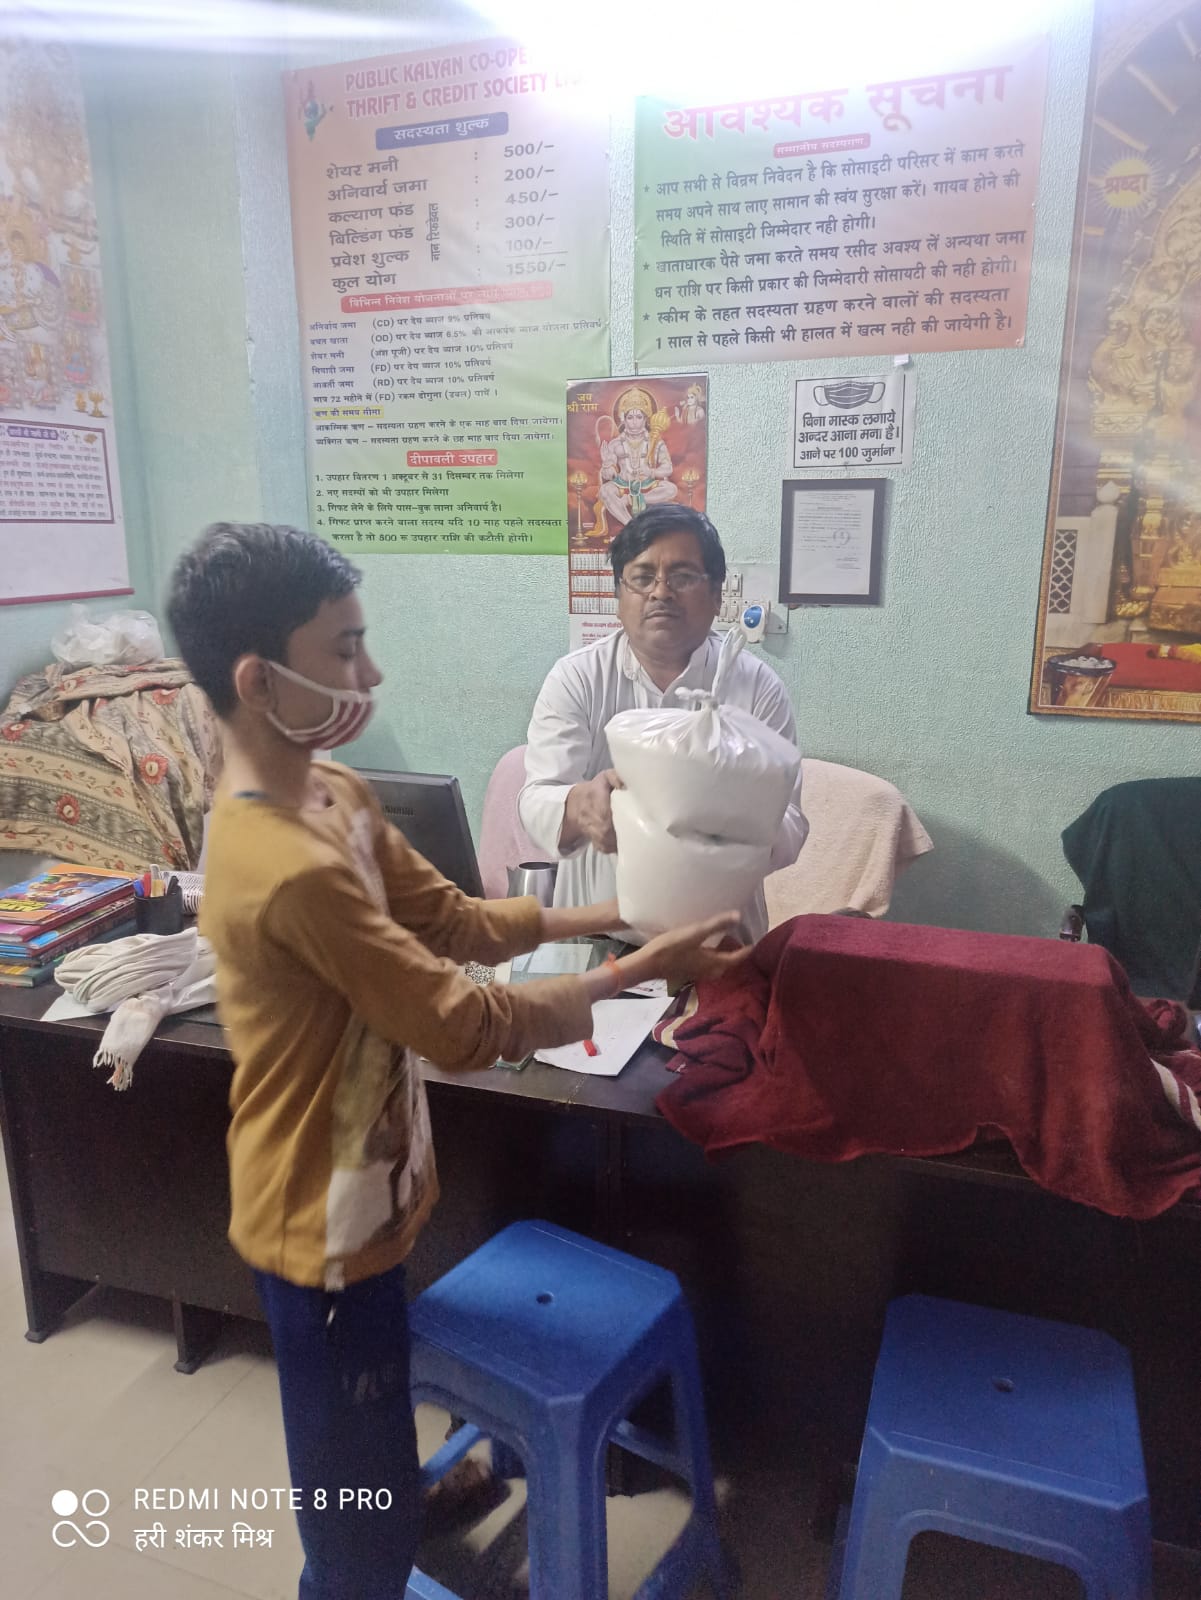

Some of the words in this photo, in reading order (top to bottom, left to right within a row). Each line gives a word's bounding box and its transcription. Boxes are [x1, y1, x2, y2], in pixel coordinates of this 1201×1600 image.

[346, 69, 399, 91] PUBLIC
[403, 56, 463, 83] KALYAN
[347, 93, 401, 117] THRIFT
[406, 92, 416, 108] &
[423, 83, 478, 107] CREDIT
[483, 73, 548, 98] SOCIETY
[664, 88, 848, 140] आवश्यक
[865, 65, 1013, 131] सूचना
[394, 123, 450, 140] सदस्यता
[455, 118, 489, 135] शुल्क
[503, 140, 555, 158] 500/-
[326, 162, 362, 179] शेयर
[367, 155, 399, 173] मनी
[504, 164, 556, 182] 200/-
[656, 181, 680, 196] आप
[683, 174, 708, 193] सभी
[712, 173, 722, 190] से
[762, 166, 803, 184] निवेदन
[805, 160, 817, 181] है
[821, 160, 837, 177] कि
[842, 154, 892, 177] सोसाइटी
[897, 150, 940, 171] परिसर
[944, 147, 956, 165] में
[961, 148, 989, 162] काम
[994, 139, 1025, 160] करते
[328, 179, 388, 201] अनिवार्य
[393, 179, 429, 193] जमा
[504, 188, 560, 205] 450/-
[656, 208, 682, 222] समय
[686, 201, 713, 219] अपने
[745, 199, 768, 215] लाए
[772, 194, 810, 210] सामान
[814, 188, 830, 206] की
[862, 186, 897, 207] सुरक्षा
[974, 171, 998, 193] होने
[1002, 168, 1021, 187] की
[328, 207, 383, 223] कल्याण
[387, 201, 415, 217] फंड
[504, 212, 556, 229] 300/-
[387, 224, 415, 240] फंड
[695, 228, 707, 244] में
[710, 223, 757, 243] सोसाइटी
[760, 219, 812, 239] जिम्मेदार
[506, 236, 553, 251] 100/-
[720, 249, 739, 268] पैसे
[744, 253, 770, 266] जमा
[775, 245, 803, 264] करते
[808, 246, 840, 260] समय
[844, 238, 878, 258] रसीद
[882, 239, 921, 255] अवश्य
[926, 233, 940, 251] लें
[945, 233, 991, 249] अन्यथा
[995, 230, 1027, 245] जमा
[331, 251, 366, 268] प्रवेश
[371, 250, 411, 268] शुल्क
[505, 258, 567, 275] 1550/-
[331, 277, 361, 293] कुल
[365, 270, 397, 286] योग
[654, 285, 673, 299] धन
[676, 279, 702, 298] राशि
[705, 282, 722, 295] पर
[726, 275, 754, 294] किसी
[758, 277, 790, 292] प्रकार
[793, 270, 809, 288] की
[813, 266, 869, 287] जिम्मेदारी
[873, 261, 926, 282] सोसायटी
[930, 259, 947, 278] की
[657, 306, 691, 324] स्कीम
[694, 305, 707, 321] के
[712, 306, 742, 321] तहत
[745, 302, 799, 319] सदस्यता
[803, 300, 838, 316] ग्रहण
[843, 293, 877, 312] करने
[882, 290, 919, 308] वालों
[924, 287, 944, 306] की
[949, 288, 1011, 304] सदस्यता
[655, 338, 662, 350] 1
[667, 335, 693, 349] साल
[697, 330, 709, 347] से
[712, 329, 741, 347] पहले
[744, 325, 776, 344] किसी
[781, 324, 796, 342] भी
[801, 326, 837, 343] हालत
[840, 321, 853, 338] में
[857, 322, 887, 338] खत्म
[921, 315, 939, 333] की
[943, 312, 991, 332] जायेगी
[580, 403, 600, 412] राम
[802, 411, 827, 428] बिना
[828, 414, 861, 427] मास्क
[862, 408, 896, 425] लगाये
[798, 430, 829, 443] अन्दर
[830, 429, 857, 441] आना
[860, 428, 883, 440] मना
[409, 452, 455, 465] दीपावली
[459, 453, 495, 464] उपहार
[799, 446, 821, 460] आने
[823, 449, 837, 459] पर
[838, 446, 859, 459] 100
[432, 472, 442, 480] 31
